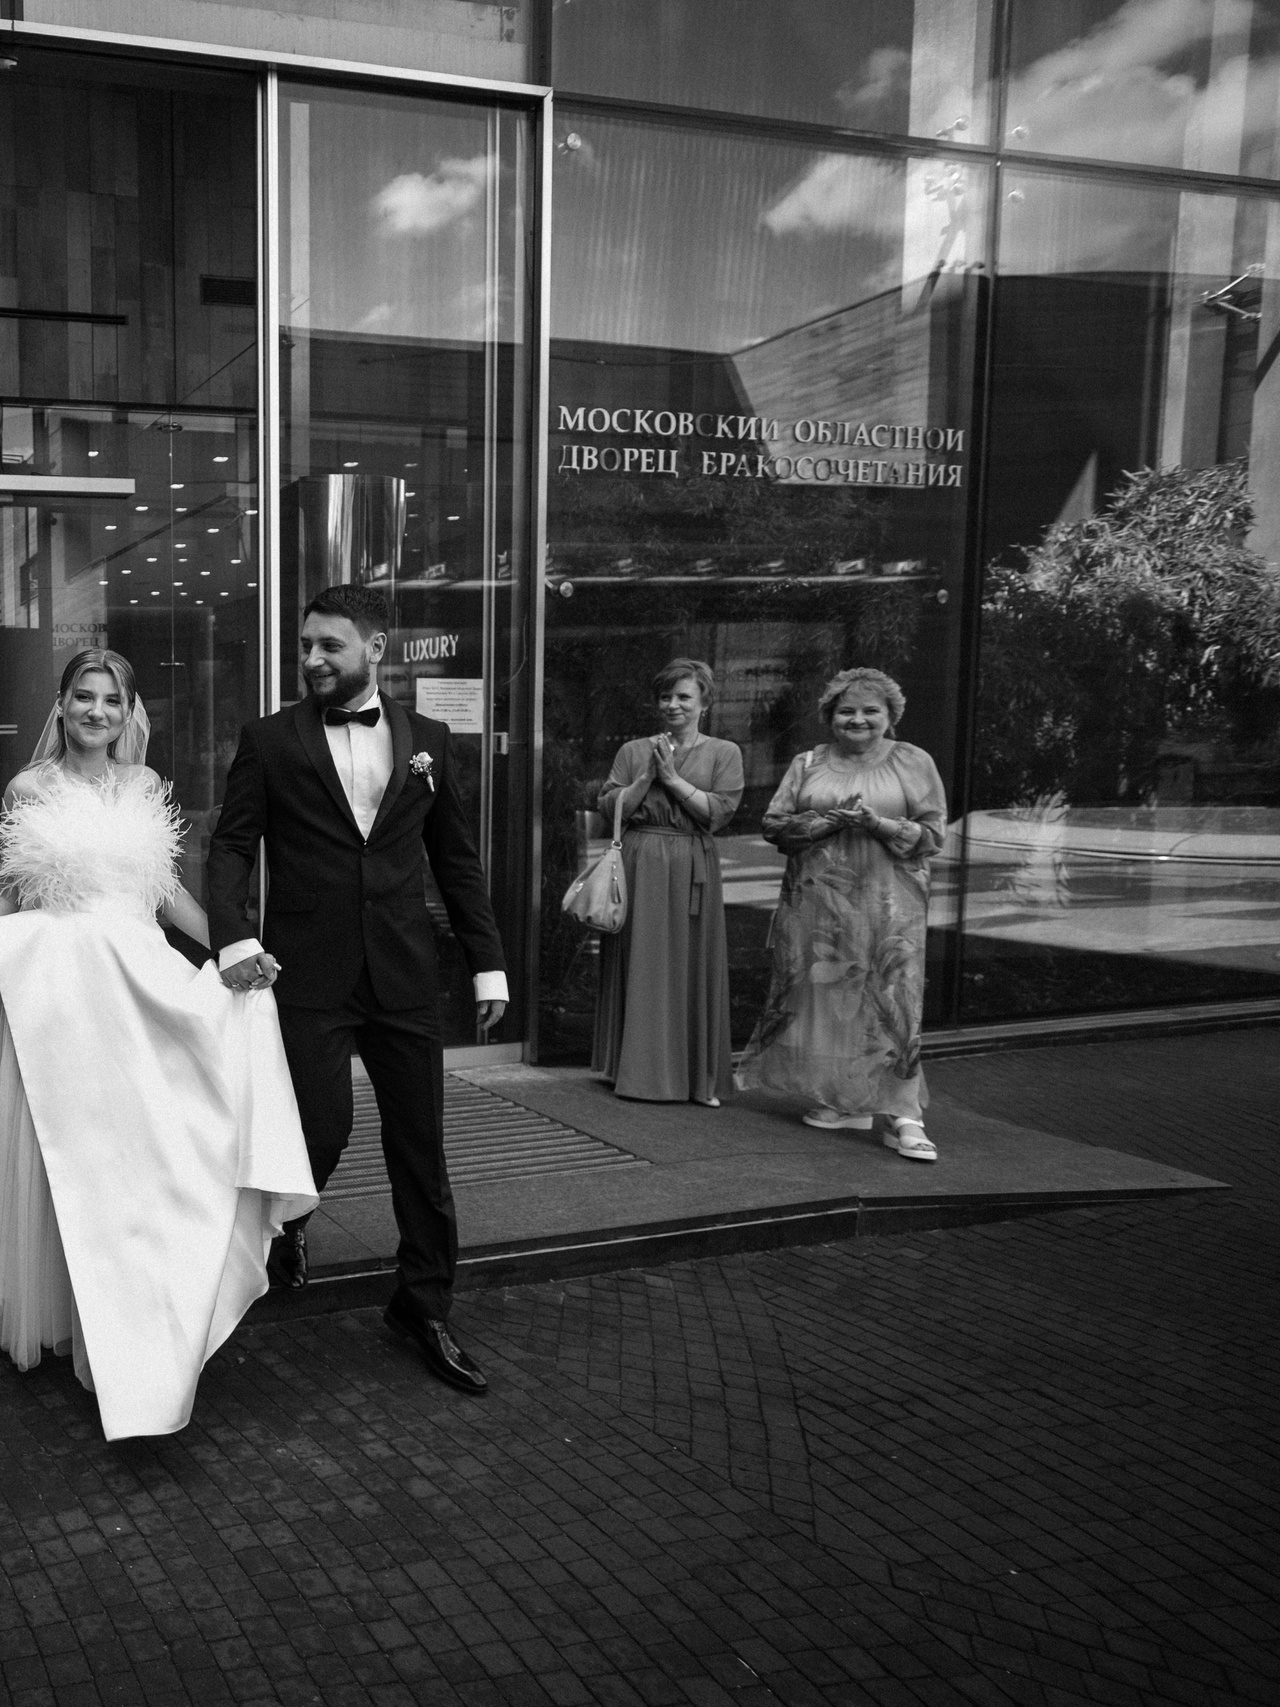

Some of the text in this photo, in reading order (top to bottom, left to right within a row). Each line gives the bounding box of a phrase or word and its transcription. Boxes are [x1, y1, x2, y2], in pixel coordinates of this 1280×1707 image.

[558, 444, 963, 487] ДВОРЕЦ БРАКОСОЧЕТАНИЯ
[403, 634, 459, 663] LUXURY
